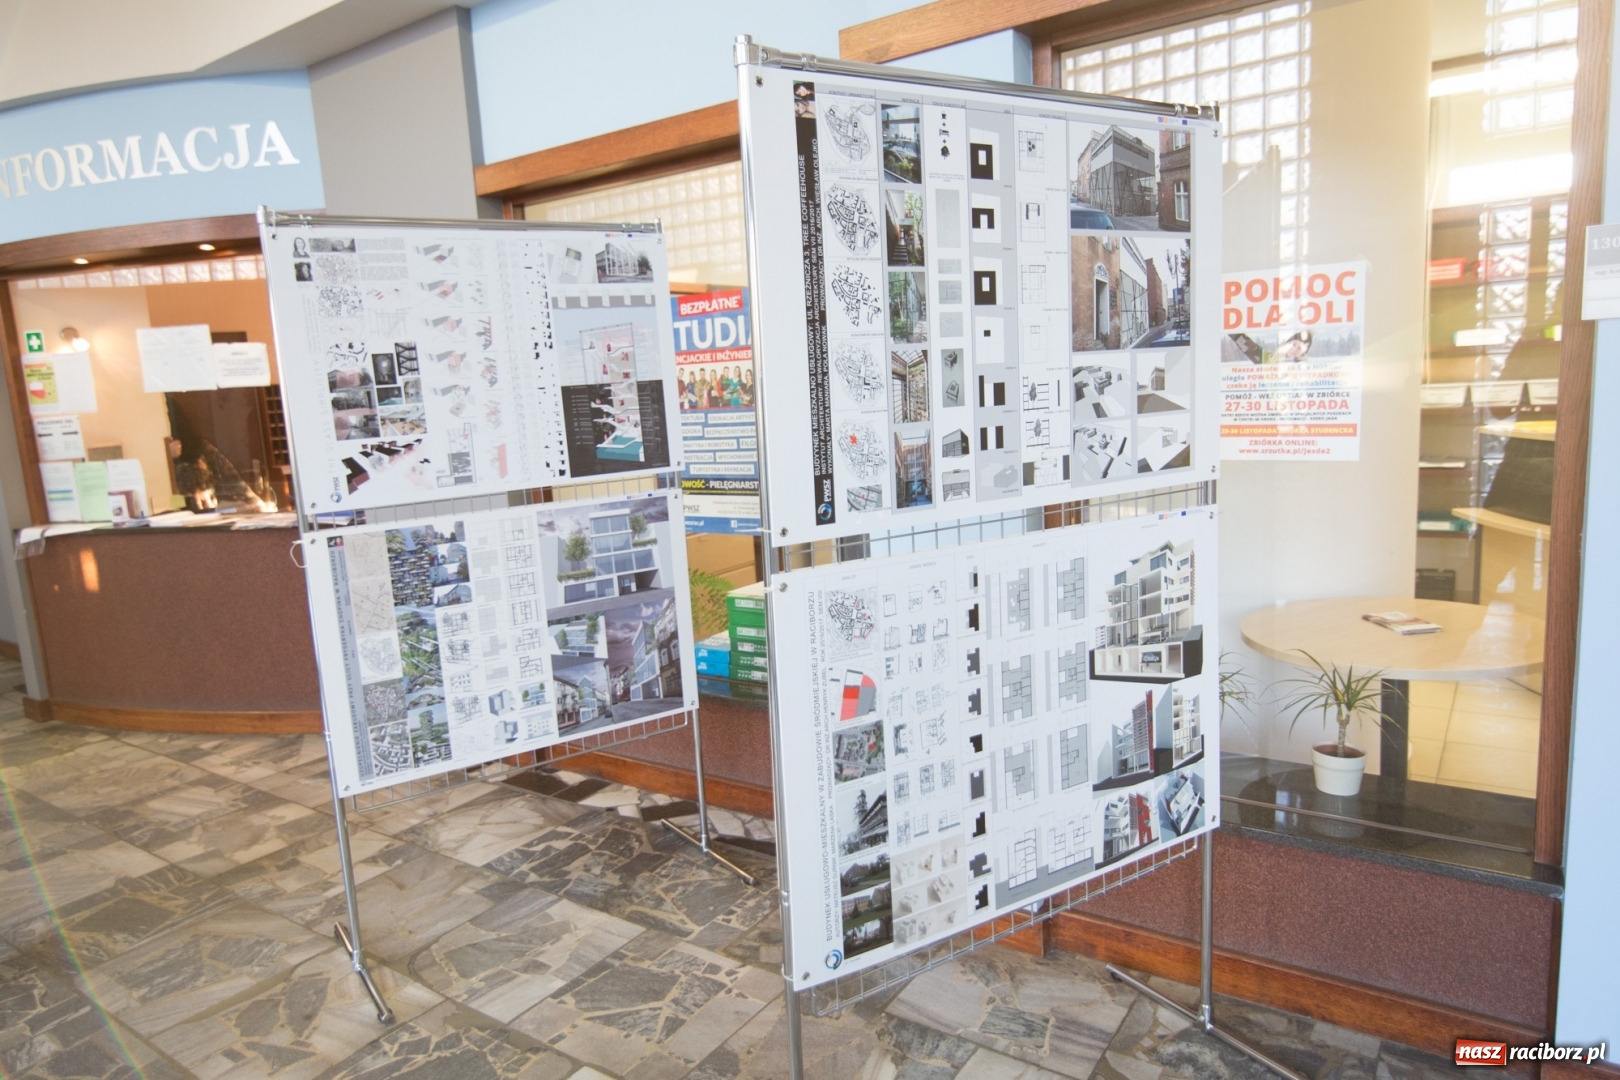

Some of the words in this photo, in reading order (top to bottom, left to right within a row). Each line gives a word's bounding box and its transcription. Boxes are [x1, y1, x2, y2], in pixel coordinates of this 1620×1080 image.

[799, 154, 808, 220] COFFEEHOUSE
[1224, 271, 1356, 305] POMOC
[680, 295, 741, 316] BEZPŁATNE
[1223, 304, 1286, 330] DLA
[1298, 299, 1355, 325] OLI
[673, 315, 751, 351] TUDI
[314, 359, 328, 414] SIMPLICITY
[1232, 366, 1254, 374] Nasza
[810, 375, 818, 429] MIESZKALNO
[1225, 392, 1252, 400] POMÓŻ
[1316, 390, 1350, 398] ZBIÓRCE
[1225, 401, 1262, 411] 27-30
[1266, 400, 1349, 411] LISTOPADA
[323, 420, 334, 451] GLASS
[331, 550, 339, 584] RACIBORZU
[341, 625, 349, 660] FRYDERYKA
[812, 657, 821, 726] ŚRÓDMIEJSKIEJ
[816, 730, 824, 781] ZABUDOWIE
[820, 795, 830, 898] USŁUGOWO-MIESZKALNY
